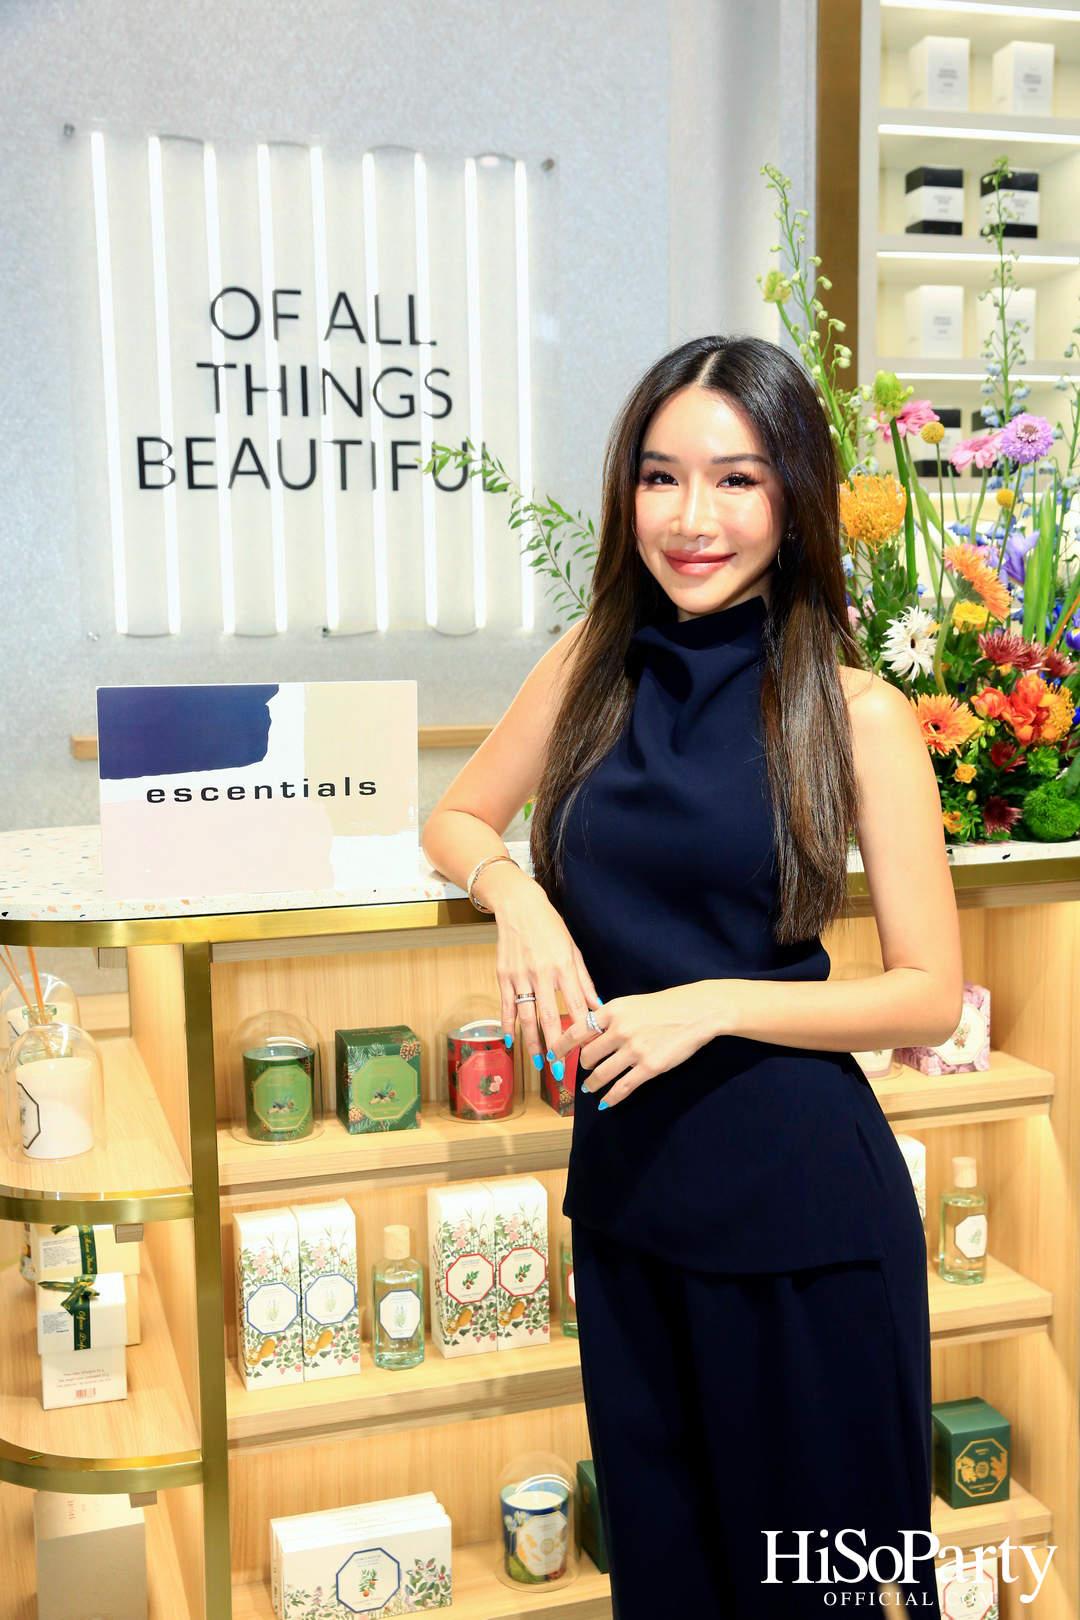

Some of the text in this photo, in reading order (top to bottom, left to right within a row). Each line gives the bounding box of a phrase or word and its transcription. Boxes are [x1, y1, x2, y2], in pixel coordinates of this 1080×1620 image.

[210, 286, 437, 346] OF ALL
[196, 362, 453, 419] THINGS
[146, 776, 377, 804] escentials
